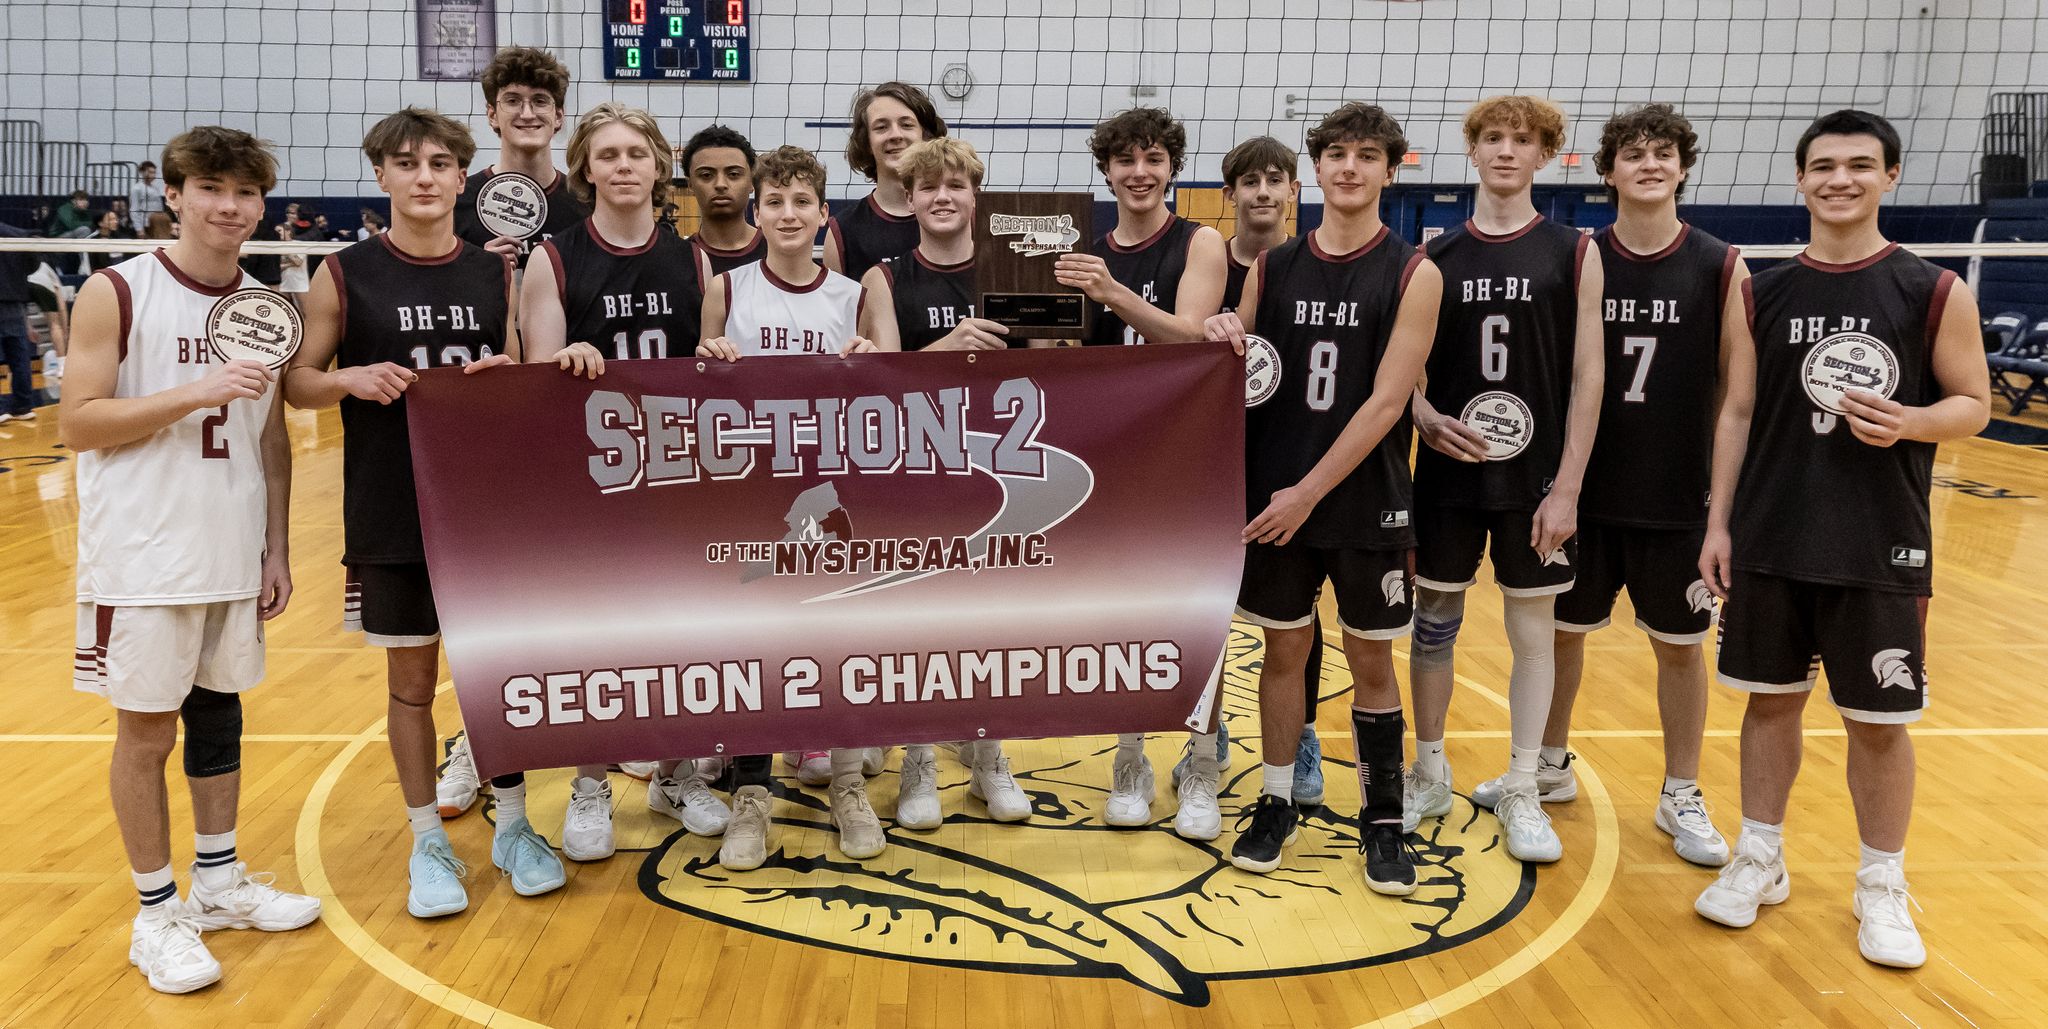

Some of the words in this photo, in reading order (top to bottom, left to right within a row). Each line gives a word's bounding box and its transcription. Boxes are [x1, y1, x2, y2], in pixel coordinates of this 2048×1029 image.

[631, 0, 646, 24] 0
[728, 0, 743, 24] 0
[611, 25, 644, 36] HOME
[670, 16, 682, 36] 0
[703, 25, 746, 37] VISITOR
[614, 38, 639, 47] FOULS
[712, 40, 737, 48] FOULS
[628, 48, 640, 67] 0
[726, 49, 738, 69] 0
[992, 215, 1058, 233] SECTION
[1061, 216, 1071, 235] 2
[1462, 276, 1532, 303] BH-BL
[603, 292, 672, 318] BH-BL
[1294, 300, 1359, 327] BH-BL
[1604, 299, 1680, 324] BH-BL
[229, 311, 276, 334] SECTION
[397, 305, 480, 331] BH-BL
[215, 333, 235, 343] BOYS
[238, 339, 283, 358] VOLLEYBALL
[760, 327, 826, 354] BH-BL
[1481, 314, 1510, 382] 6
[1246, 358, 1268, 379] SECT
[1306, 341, 1339, 411] 8
[1623, 336, 1658, 403] 7
[1823, 355, 1871, 376] SECTION
[1809, 378, 1829, 388] BOYS
[202, 403, 230, 459] 2
[585, 386, 972, 494] SECTION
[992, 377, 1047, 480] 2
[706, 543, 730, 563] OF
[735, 541, 772, 562] THE
[985, 533, 1054, 568] INC.
[501, 658, 763, 729] SECTION
[781, 656, 822, 710] 2
[838, 639, 1182, 705] CHAMPIONS
